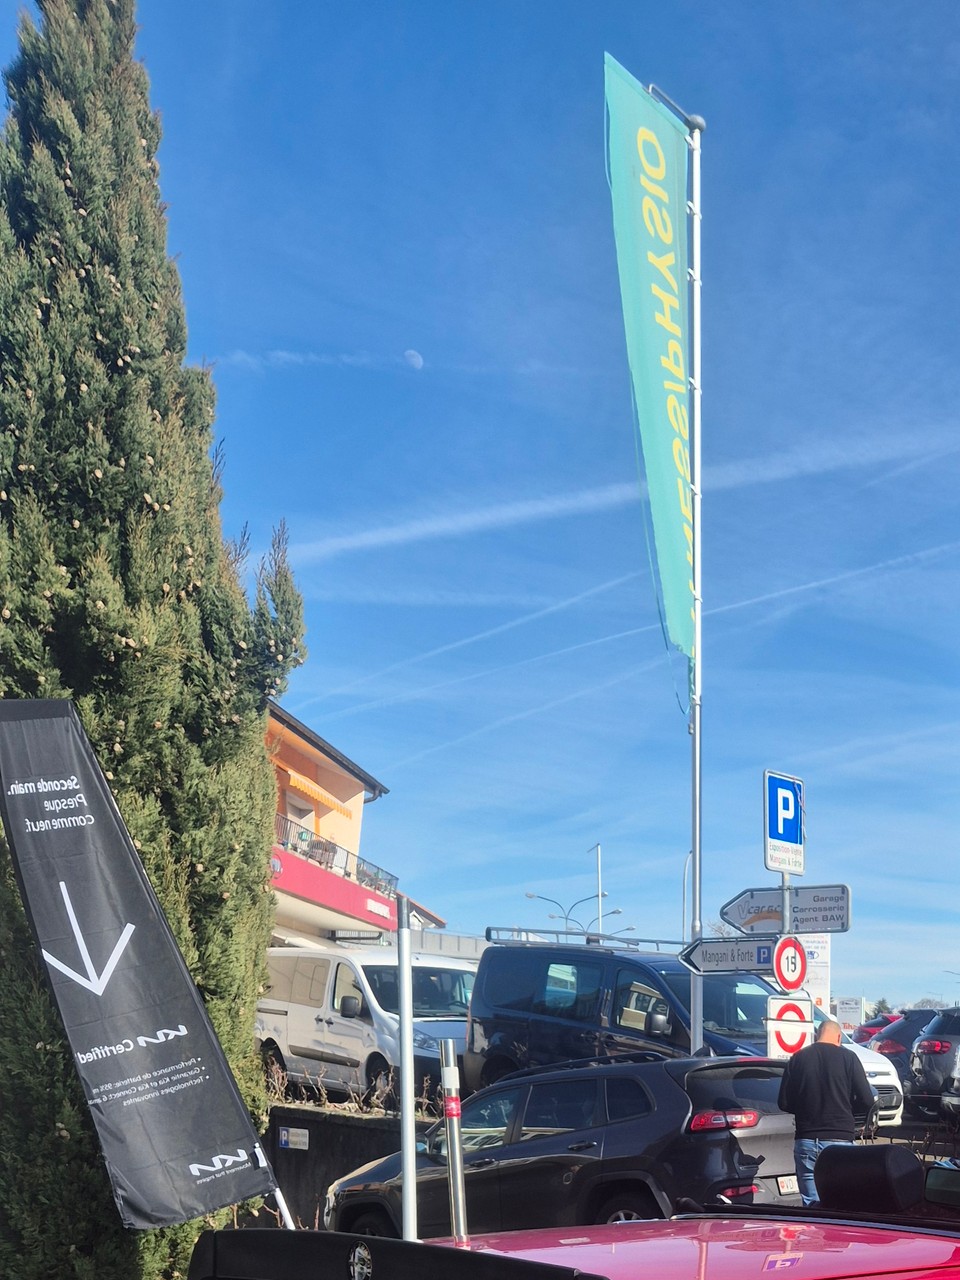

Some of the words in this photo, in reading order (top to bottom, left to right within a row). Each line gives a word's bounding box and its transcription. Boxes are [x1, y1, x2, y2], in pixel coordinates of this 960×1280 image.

[777, 787, 795, 834] P
[812, 895, 845, 903] Garage
[792, 906, 844, 914] Carrosserie
[792, 916, 818, 924] Agent
[822, 914, 845, 922] BAW
[702, 949, 729, 966] Mangani
[730, 949, 735, 962] &
[737, 949, 754, 962] Forte
[785, 955, 797, 973] 15
